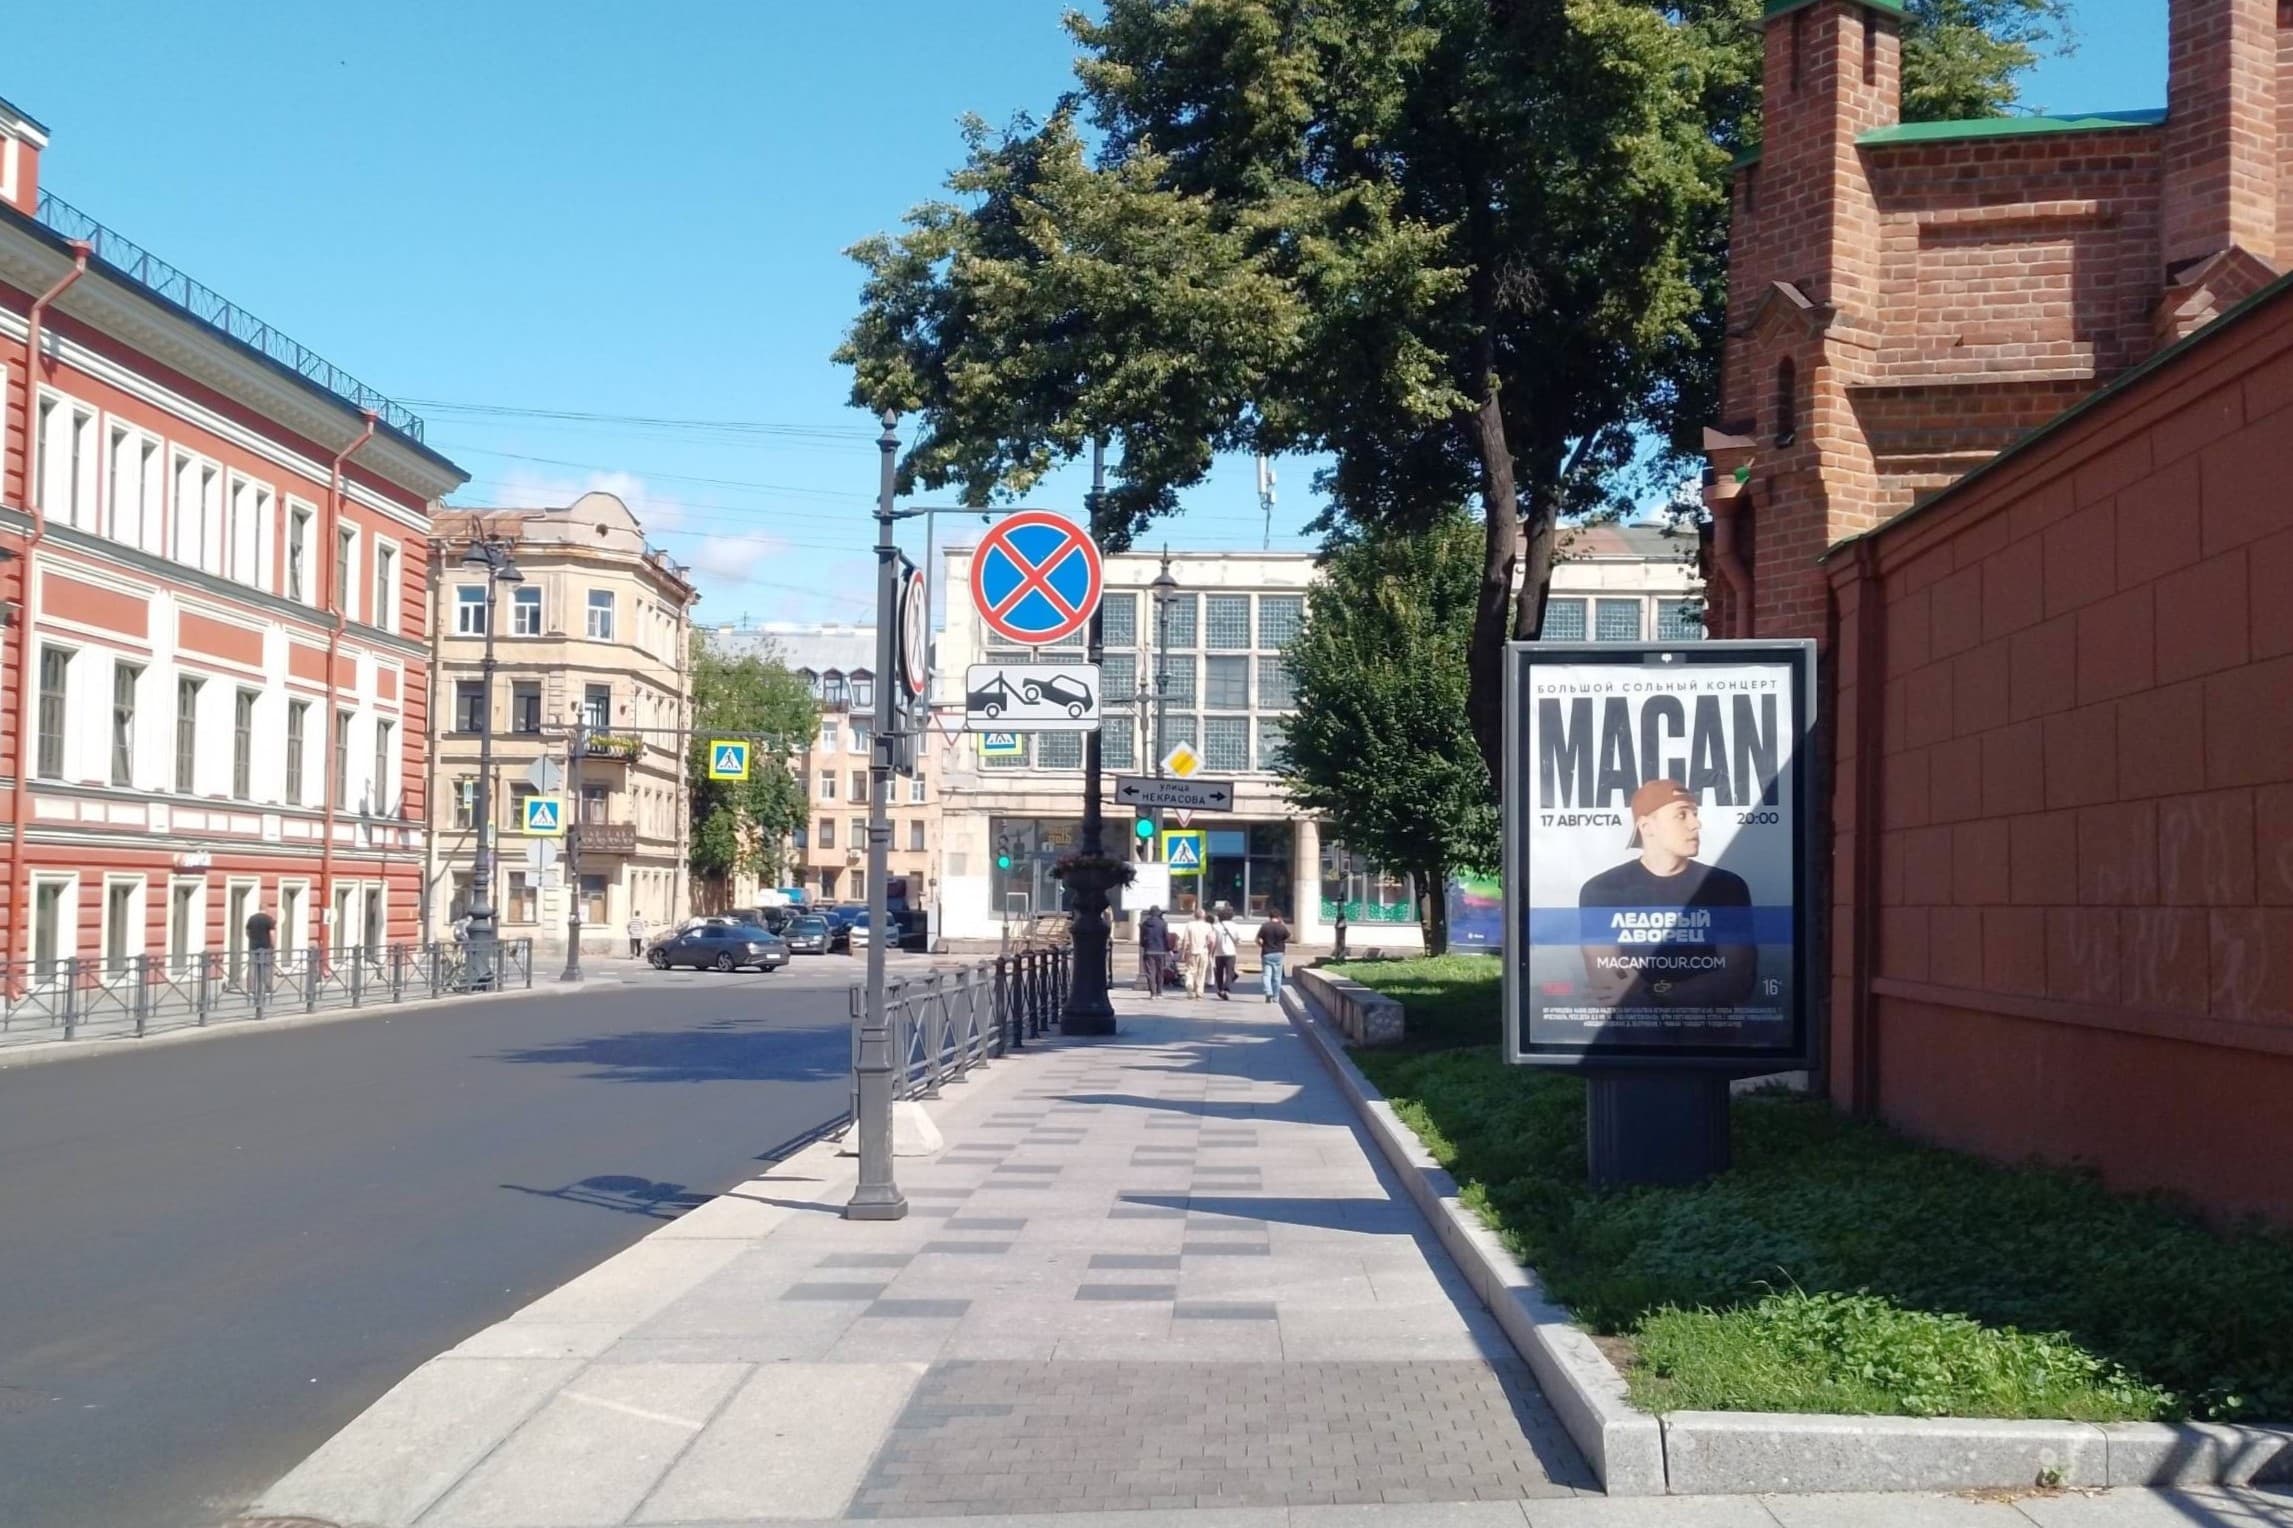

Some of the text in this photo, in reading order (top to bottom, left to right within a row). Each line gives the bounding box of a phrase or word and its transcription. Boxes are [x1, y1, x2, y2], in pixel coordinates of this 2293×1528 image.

[1537, 679, 1777, 694] БОЛЬШОЙ СОЛЬНЫЙ КОНЦЕРТ
[1538, 694, 1779, 809] MACAN
[1142, 793, 1206, 805] НЕКРАСОВА
[1540, 813, 1622, 827] 17 АВГУСТА
[1736, 812, 1779, 825] 20:00
[1611, 910, 1711, 929] ЛЕДОВЫЙ
[1617, 929, 1705, 943] ДВОРЕЦ
[1596, 956, 1726, 969] MACANTOUR.COM
